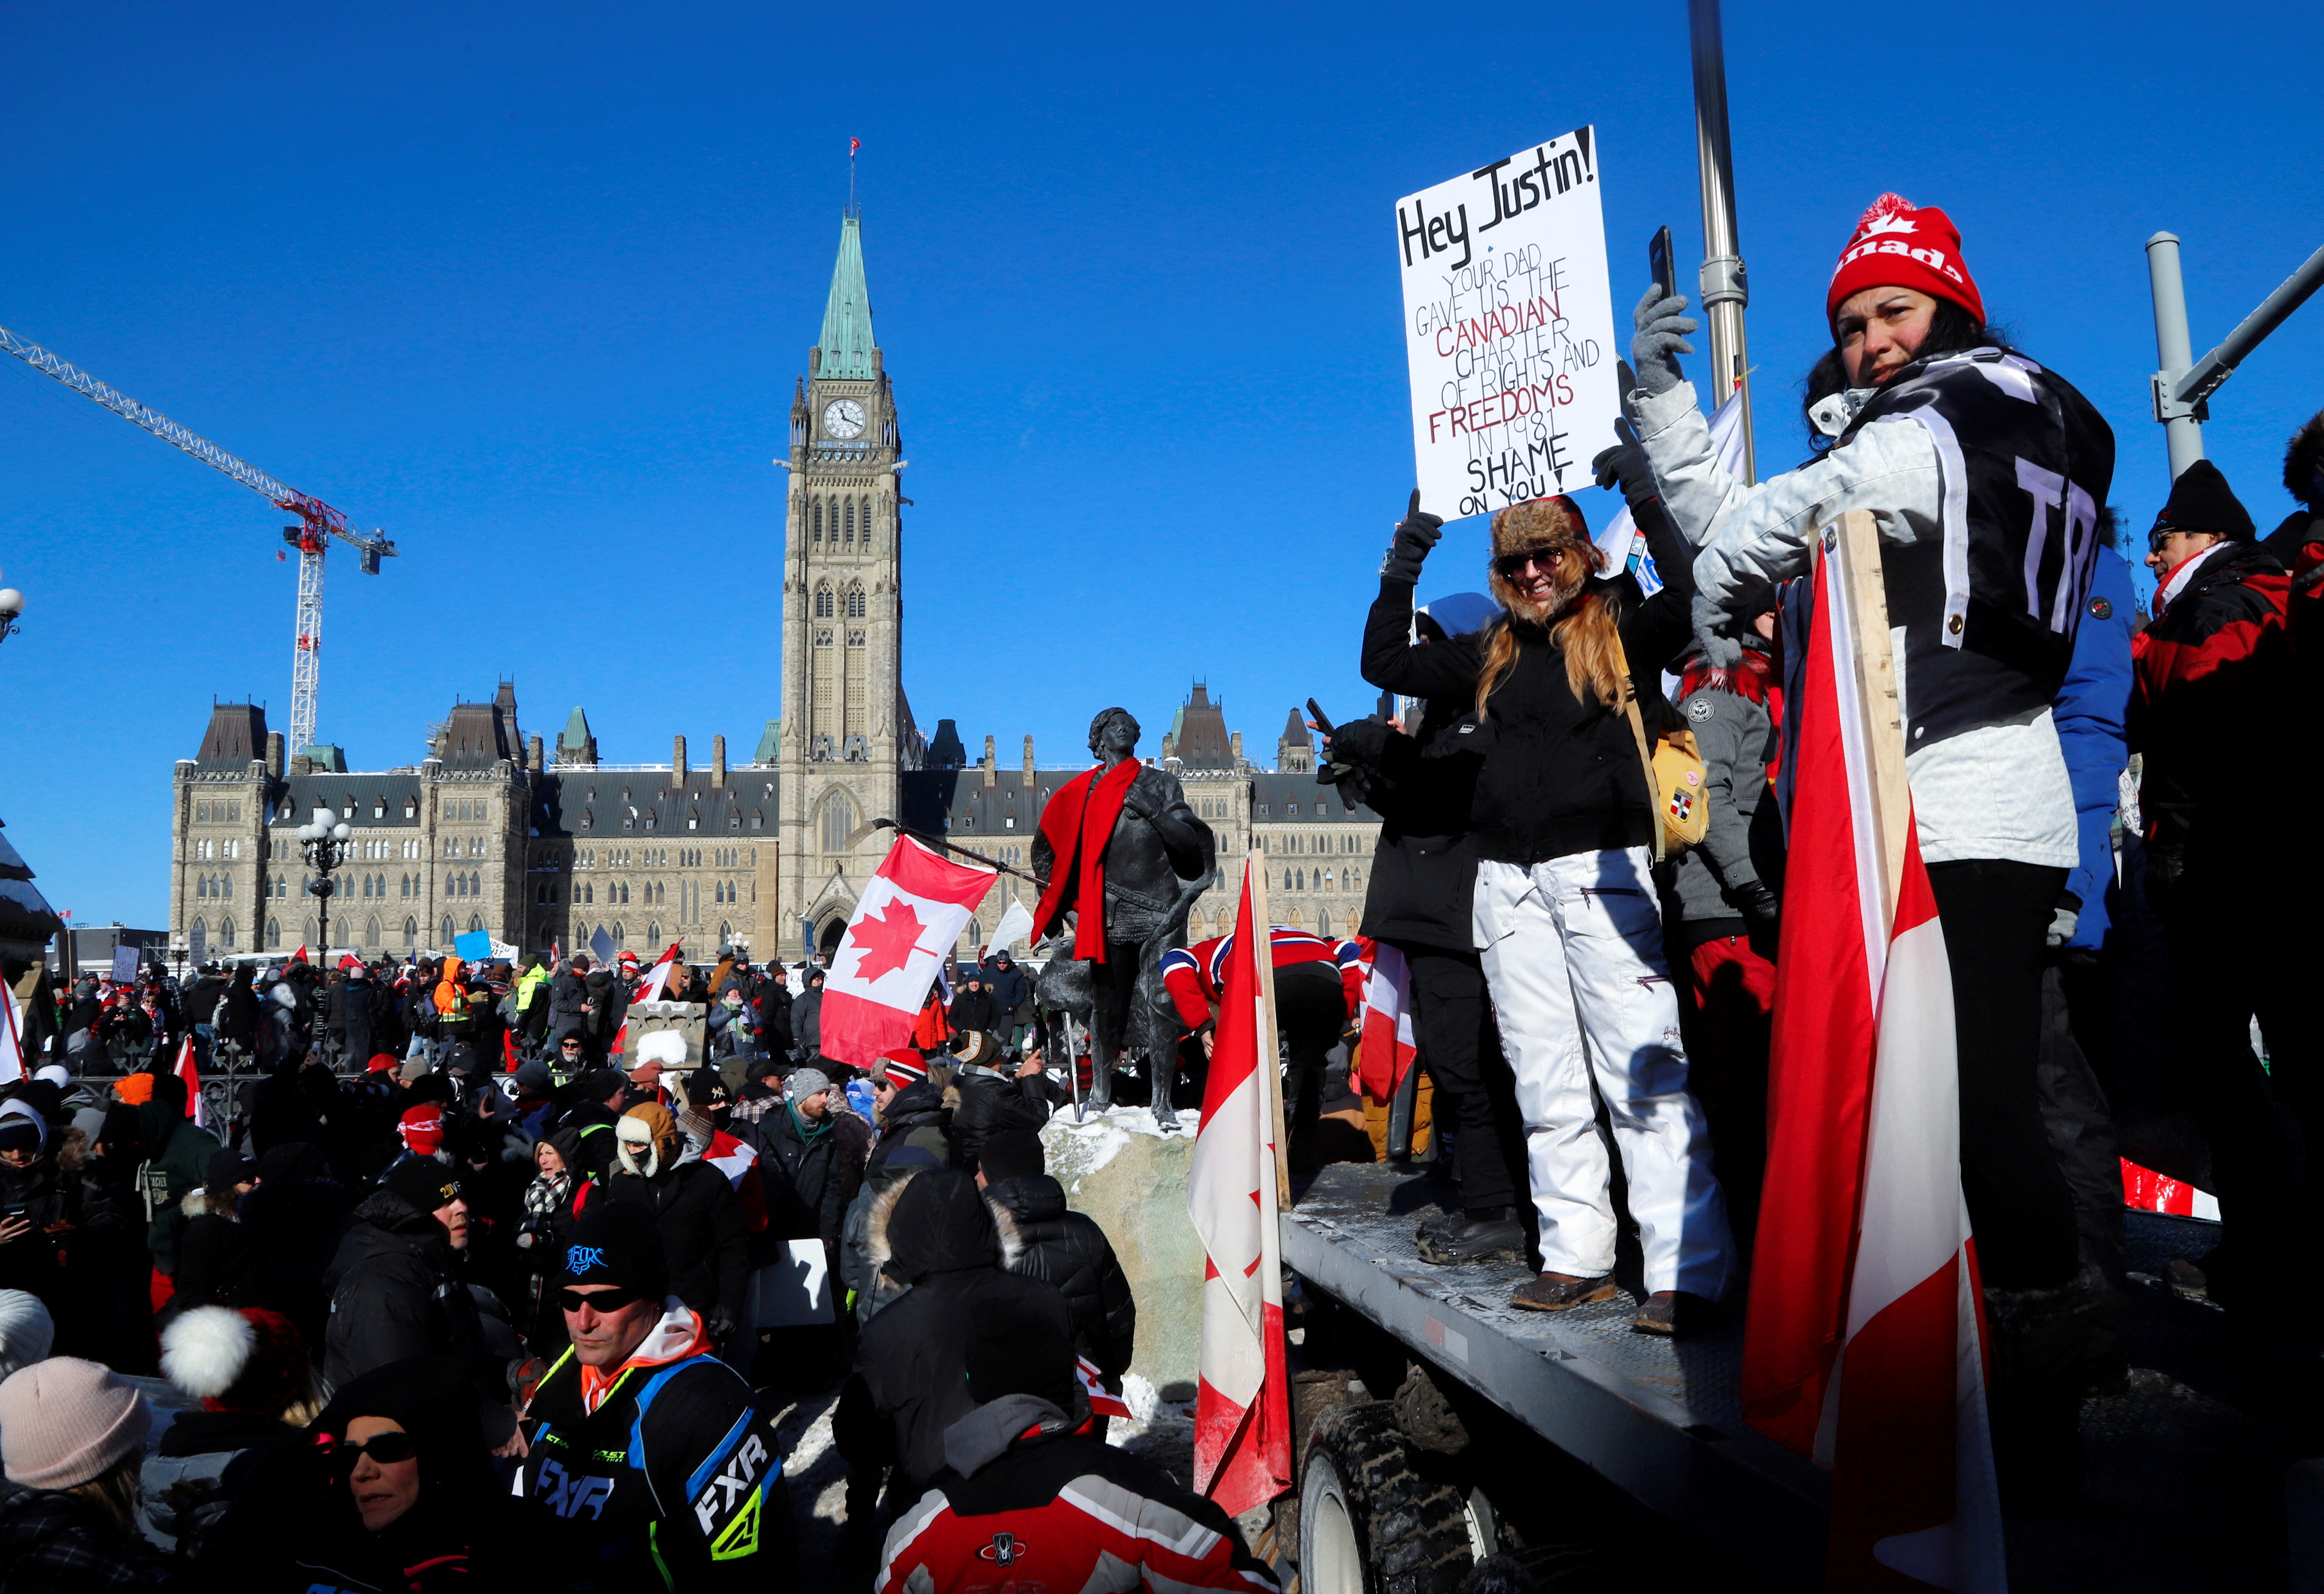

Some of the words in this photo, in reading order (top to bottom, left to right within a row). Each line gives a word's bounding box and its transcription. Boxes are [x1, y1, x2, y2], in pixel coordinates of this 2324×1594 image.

[1399, 199, 1471, 271] Hey
[1472, 125, 1594, 232] Justin!
[1416, 293, 1468, 336] GAVE
[1480, 280, 1509, 314] US
[1519, 257, 1570, 298] THE
[1442, 259, 1497, 297] YOUR
[1505, 244, 1541, 278] DAD
[1436, 290, 1560, 357] CANADIAN
[1455, 317, 1571, 377] CHARTER
[1441, 376, 1470, 410] OF
[1480, 351, 1554, 400] RIGHTS
[1563, 339, 1599, 375] AND
[1429, 374, 1574, 444] FREEDOMS
[1468, 427, 1492, 460] IN
[1503, 408, 1558, 450] 1981
[1467, 432, 1573, 493] SHAME
[1459, 493, 1487, 515] ON
[534, 1457, 614, 1520] FXR
[695, 1434, 768, 1536] FXR
